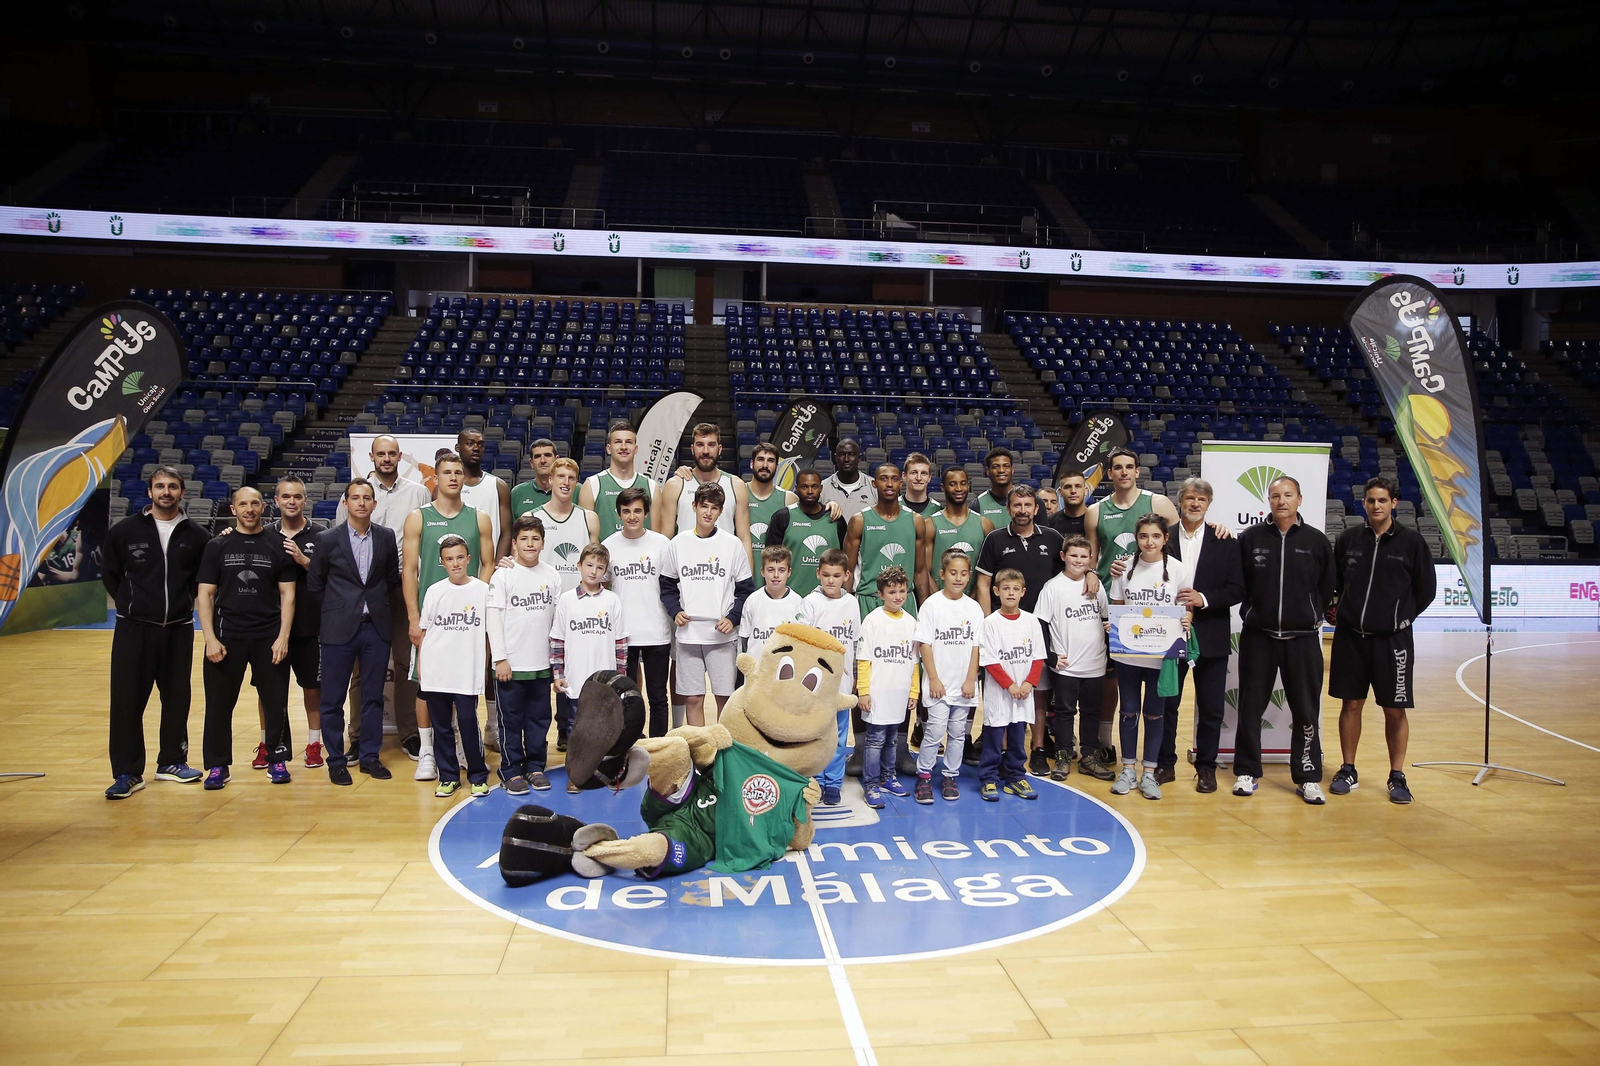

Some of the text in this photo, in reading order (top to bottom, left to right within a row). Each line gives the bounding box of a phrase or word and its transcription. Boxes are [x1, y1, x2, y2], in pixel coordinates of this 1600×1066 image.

[137, 384, 159, 407] Unicaja
[142, 400, 155, 414] Obra
[61, 552, 75, 568] 16
[555, 564, 578, 574] Unicaja
[1394, 649, 1408, 703] SPALDING
[696, 794, 717, 809] 3
[546, 869, 1074, 910] de Málaga
